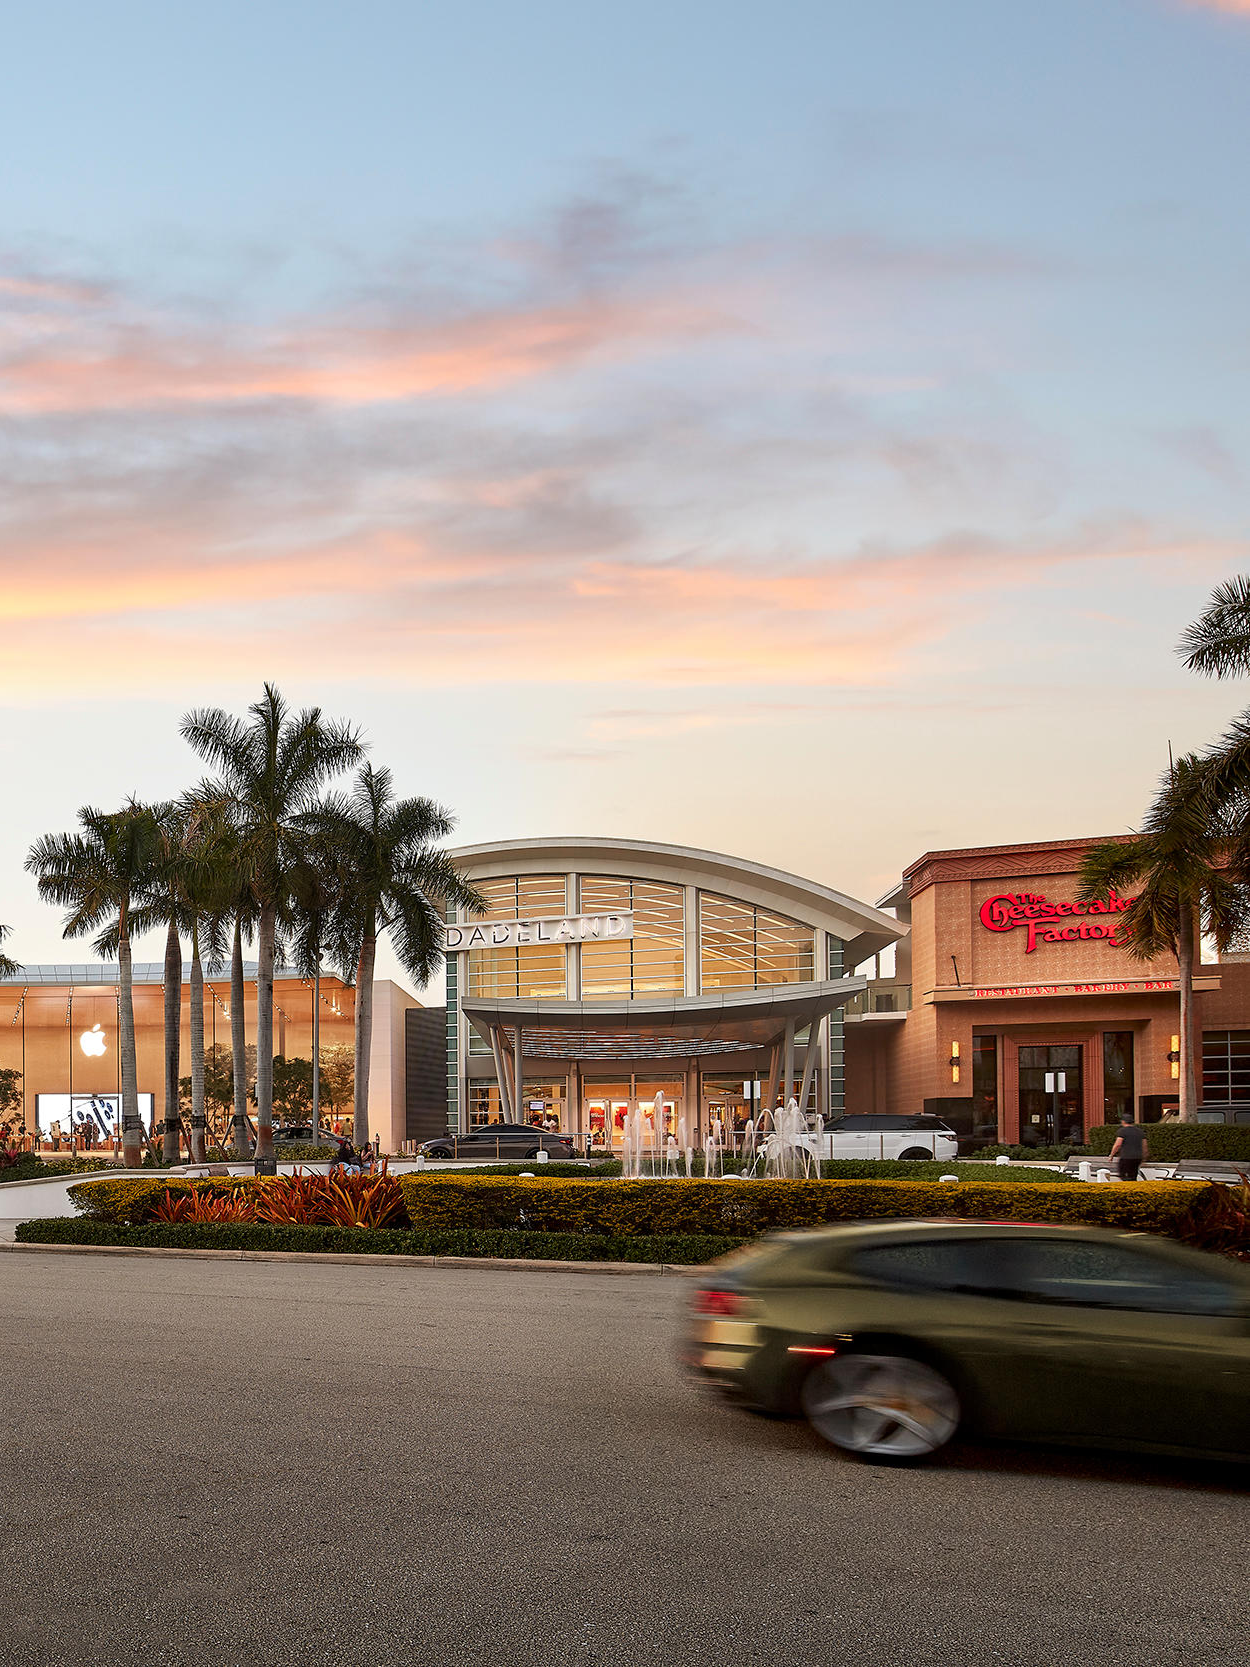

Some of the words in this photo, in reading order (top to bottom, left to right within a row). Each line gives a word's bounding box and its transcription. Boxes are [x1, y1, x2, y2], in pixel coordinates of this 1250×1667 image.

[1016, 893, 1047, 905] The
[446, 914, 627, 947] DADELAND
[975, 985, 1060, 998] RESTAURANT
[1073, 982, 1130, 993] BAKERY
[1144, 980, 1173, 990] BAR
